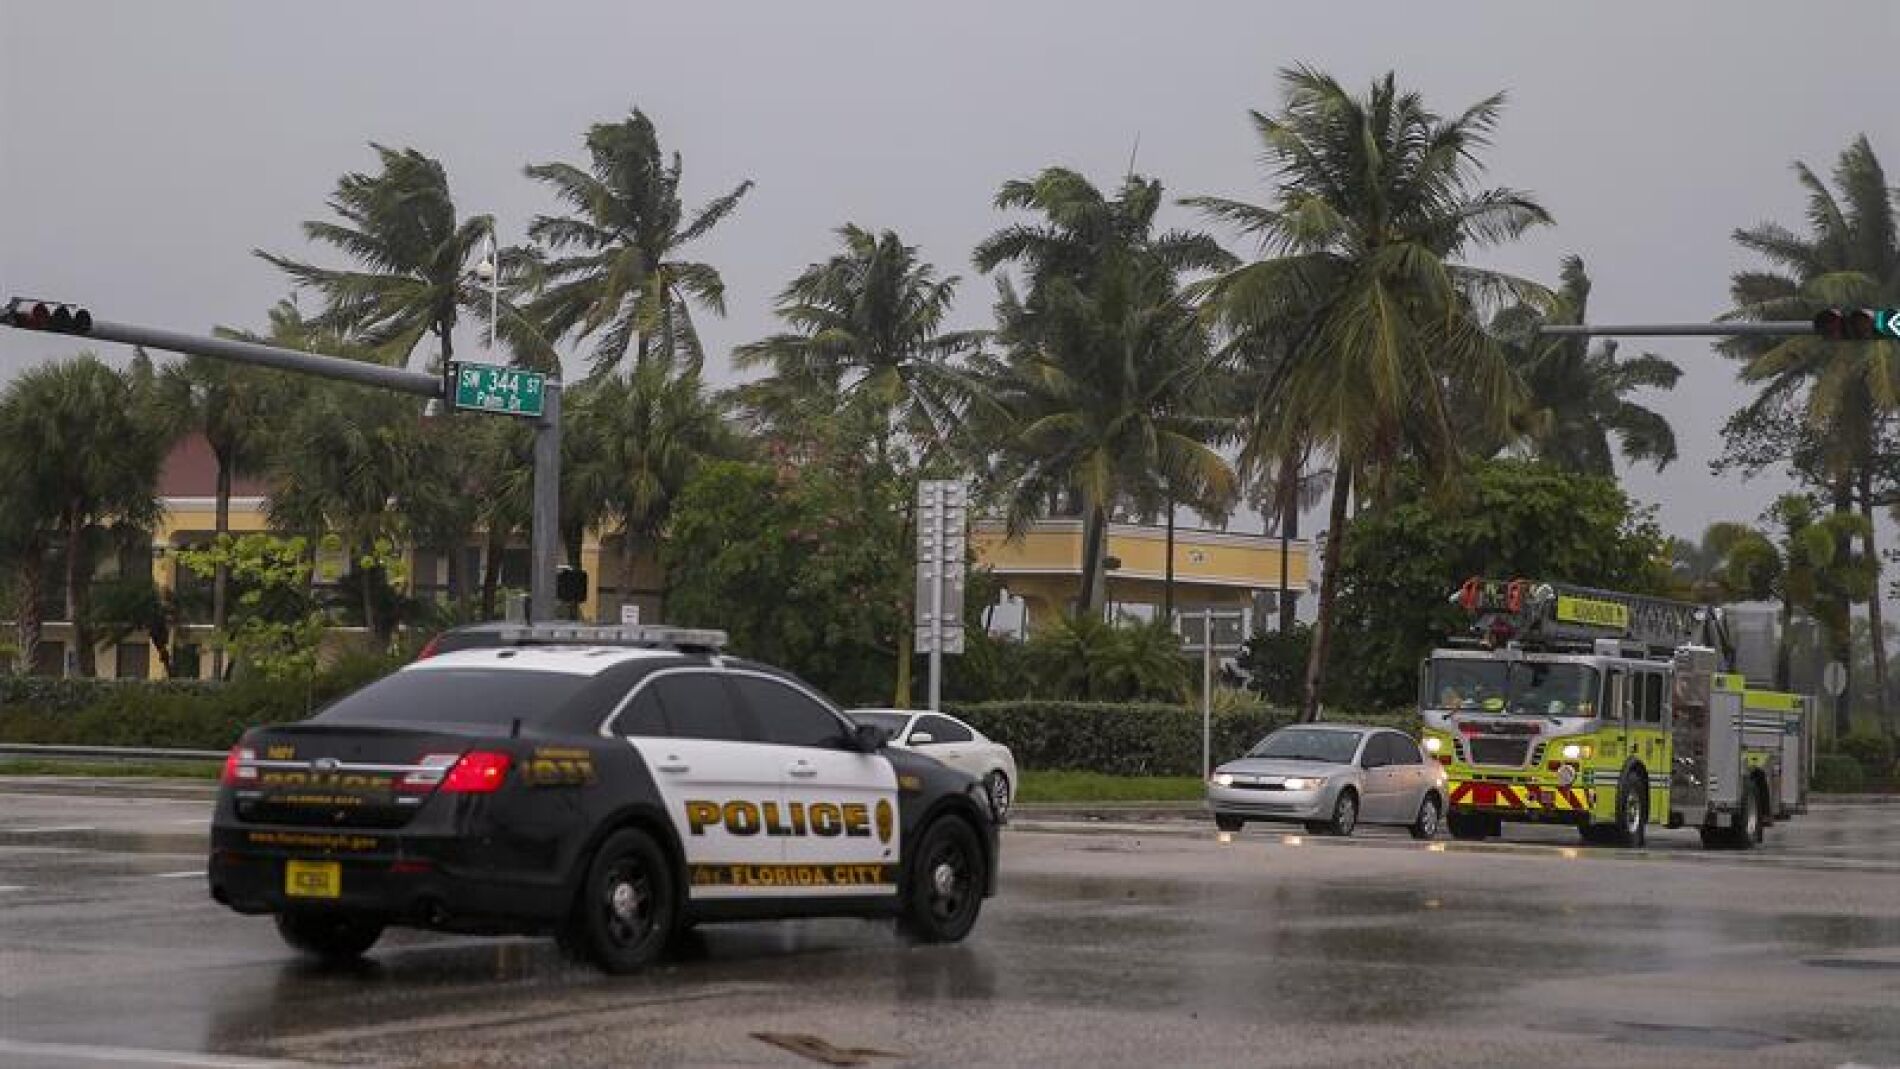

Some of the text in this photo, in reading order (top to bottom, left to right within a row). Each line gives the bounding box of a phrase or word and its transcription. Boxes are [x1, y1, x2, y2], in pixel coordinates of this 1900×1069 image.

[462, 367, 540, 394] SW 344 ST
[684, 800, 873, 837] POLICE
[730, 864, 828, 886] FLORIDA
[834, 864, 883, 885] CITY
